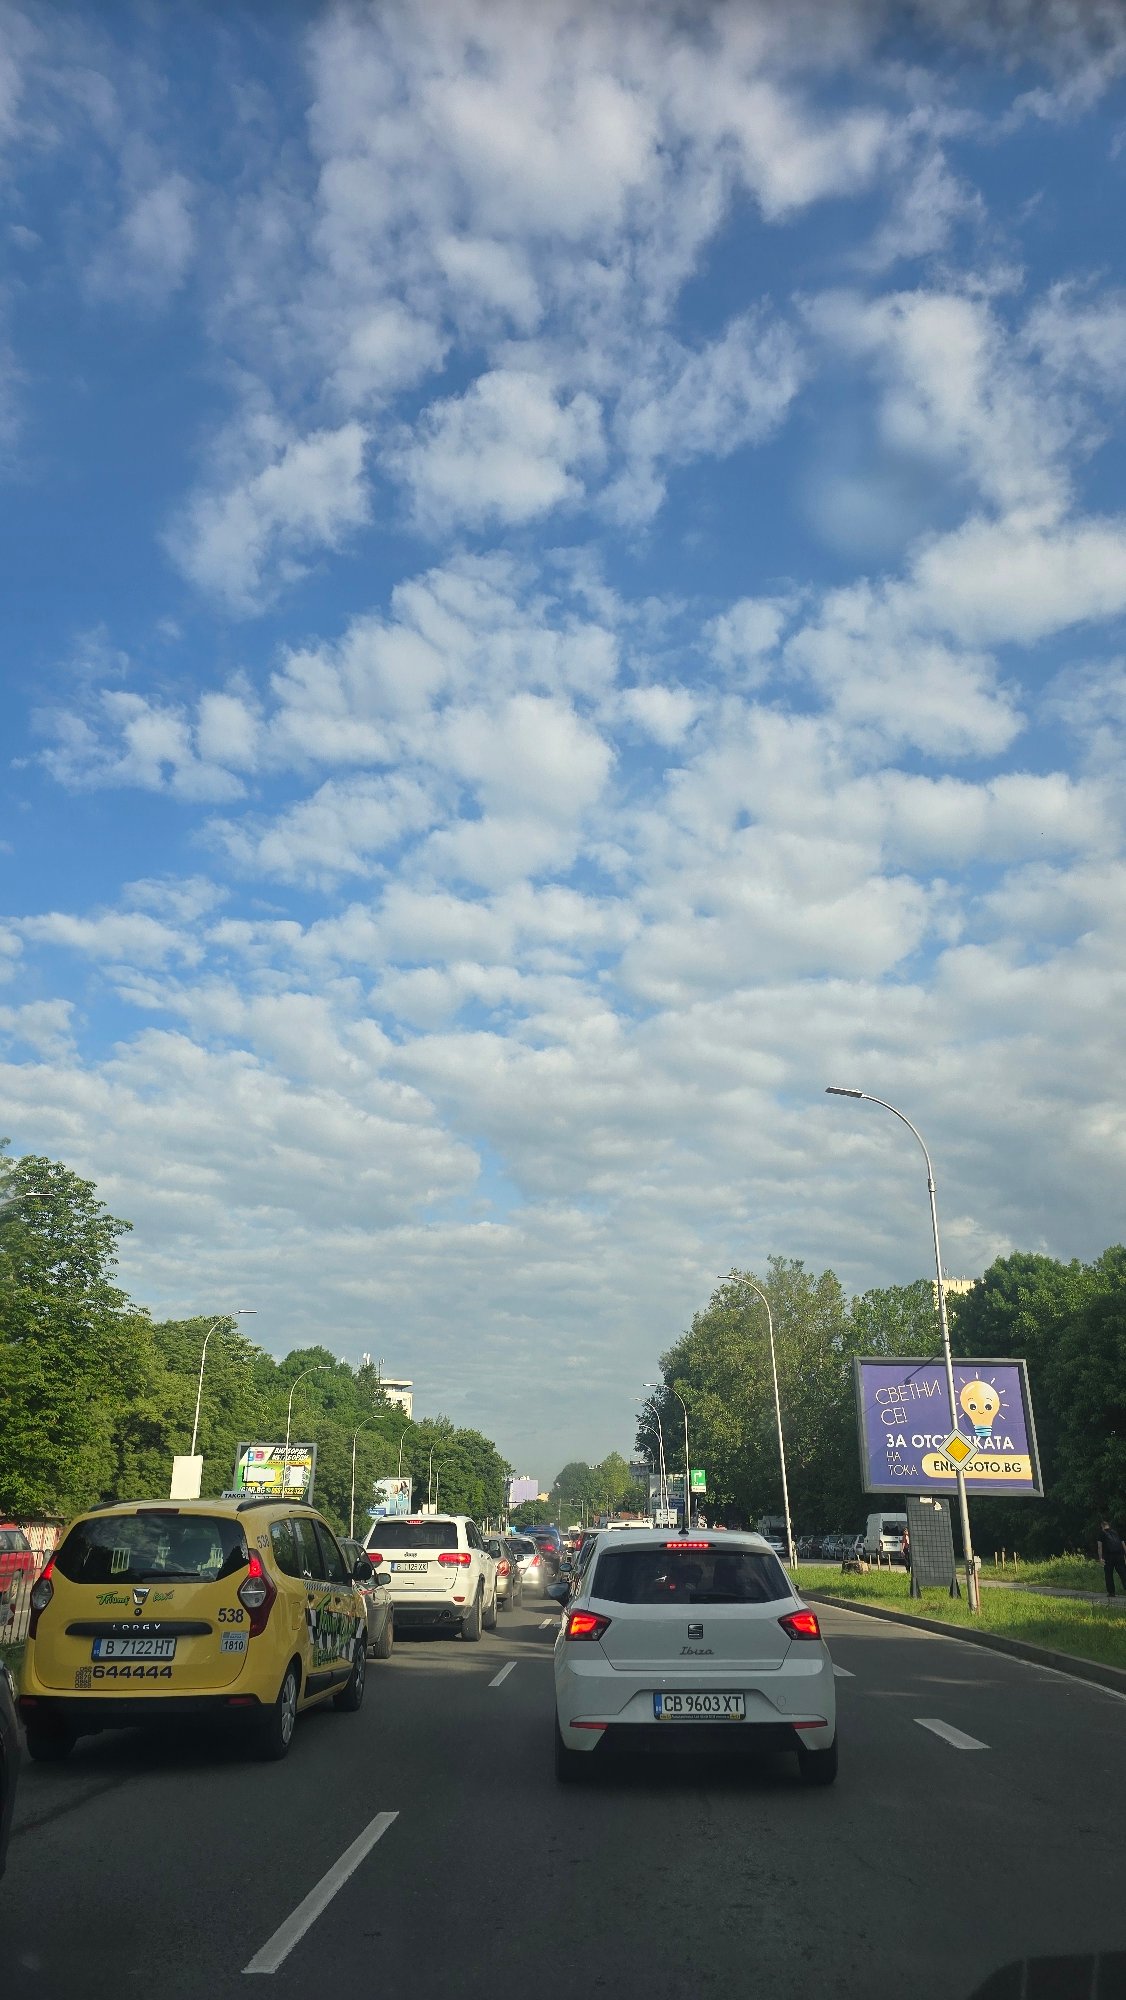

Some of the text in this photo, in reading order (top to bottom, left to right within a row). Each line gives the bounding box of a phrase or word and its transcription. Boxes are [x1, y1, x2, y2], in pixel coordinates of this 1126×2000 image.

[876, 1379, 942, 1405] СВЕТНИ
[881, 1406, 908, 1425] СЕ!
[886, 1434, 1015, 1450] ЗА ОТСКАТА
[886, 1451, 902, 1462] НА
[888, 1464, 919, 1476] ТОКА
[934, 1461, 1022, 1473] ENEGOTO.BG
[218, 1608, 244, 1623] 538
[105, 1640, 115, 1655] B
[224, 1640, 244, 1650] 1810
[679, 1646, 715, 1656] Ibiza
[92, 1665, 173, 1679] 644444
[664, 1695, 742, 1712] CB 9603 XT
